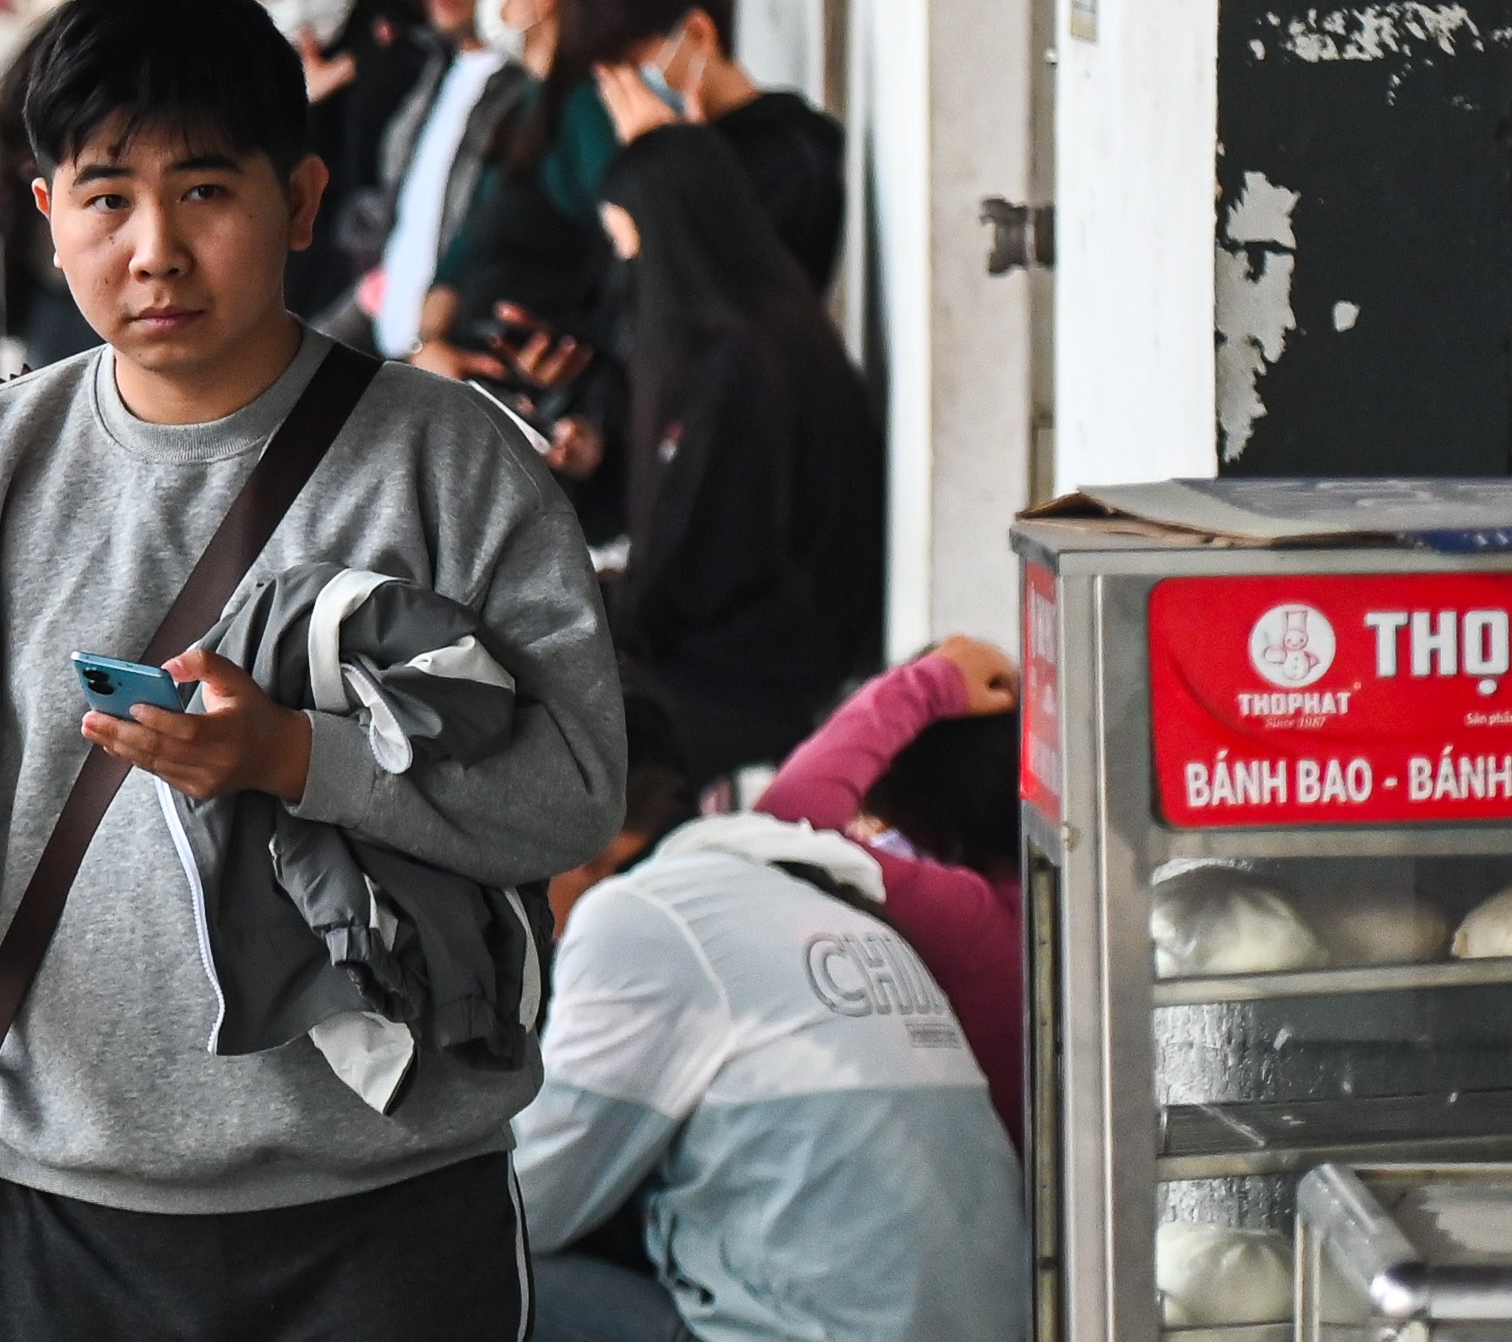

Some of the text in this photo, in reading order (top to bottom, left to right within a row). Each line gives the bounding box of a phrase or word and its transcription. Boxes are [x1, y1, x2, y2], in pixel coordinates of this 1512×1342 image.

[1366, 609, 1511, 694] THỌ
[1239, 691, 1351, 716] THOPHAT
[1185, 750, 1287, 806] BÁNH
[1297, 758, 1373, 803] BAO
[1408, 744, 1512, 801] BÁNH
